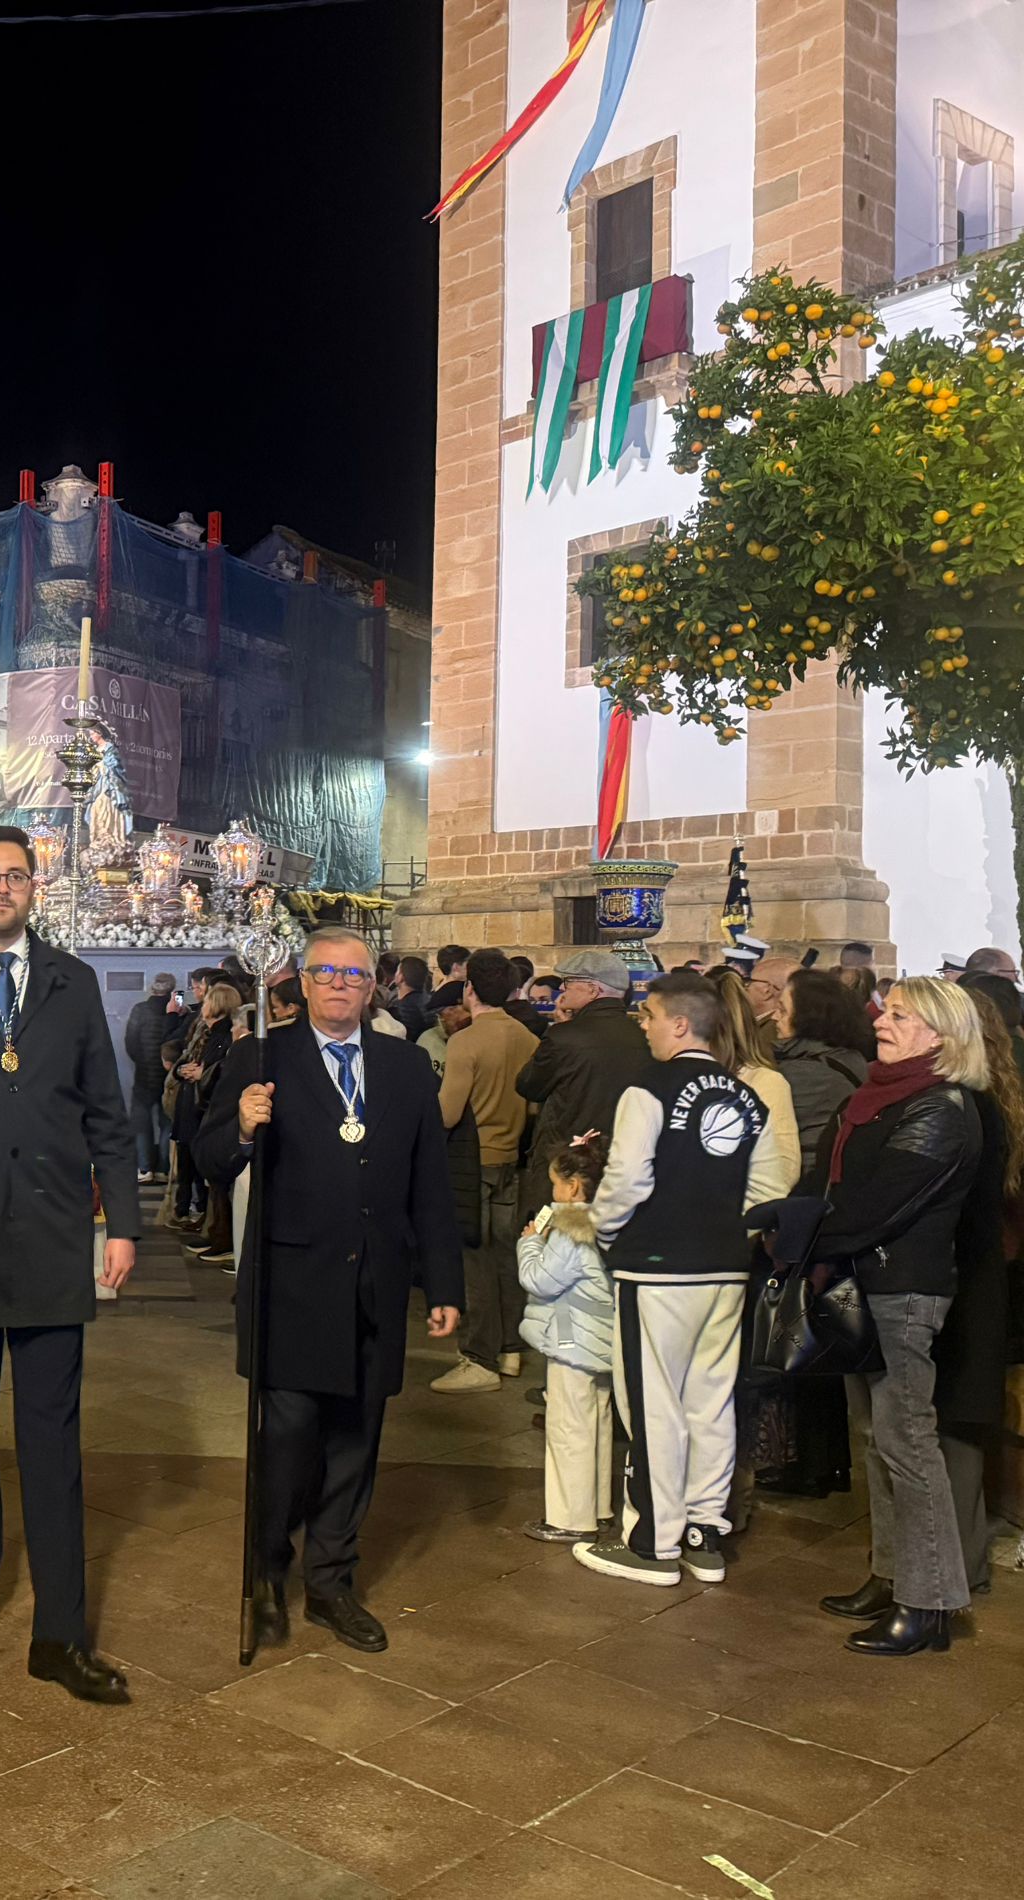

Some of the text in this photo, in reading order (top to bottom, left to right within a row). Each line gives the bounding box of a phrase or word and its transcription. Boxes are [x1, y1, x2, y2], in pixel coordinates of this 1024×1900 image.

[111, 700, 151, 723] MILLÁN
[26, 735, 38, 746] 12
[669, 1074, 763, 1135] NEVER BACK DOWN
